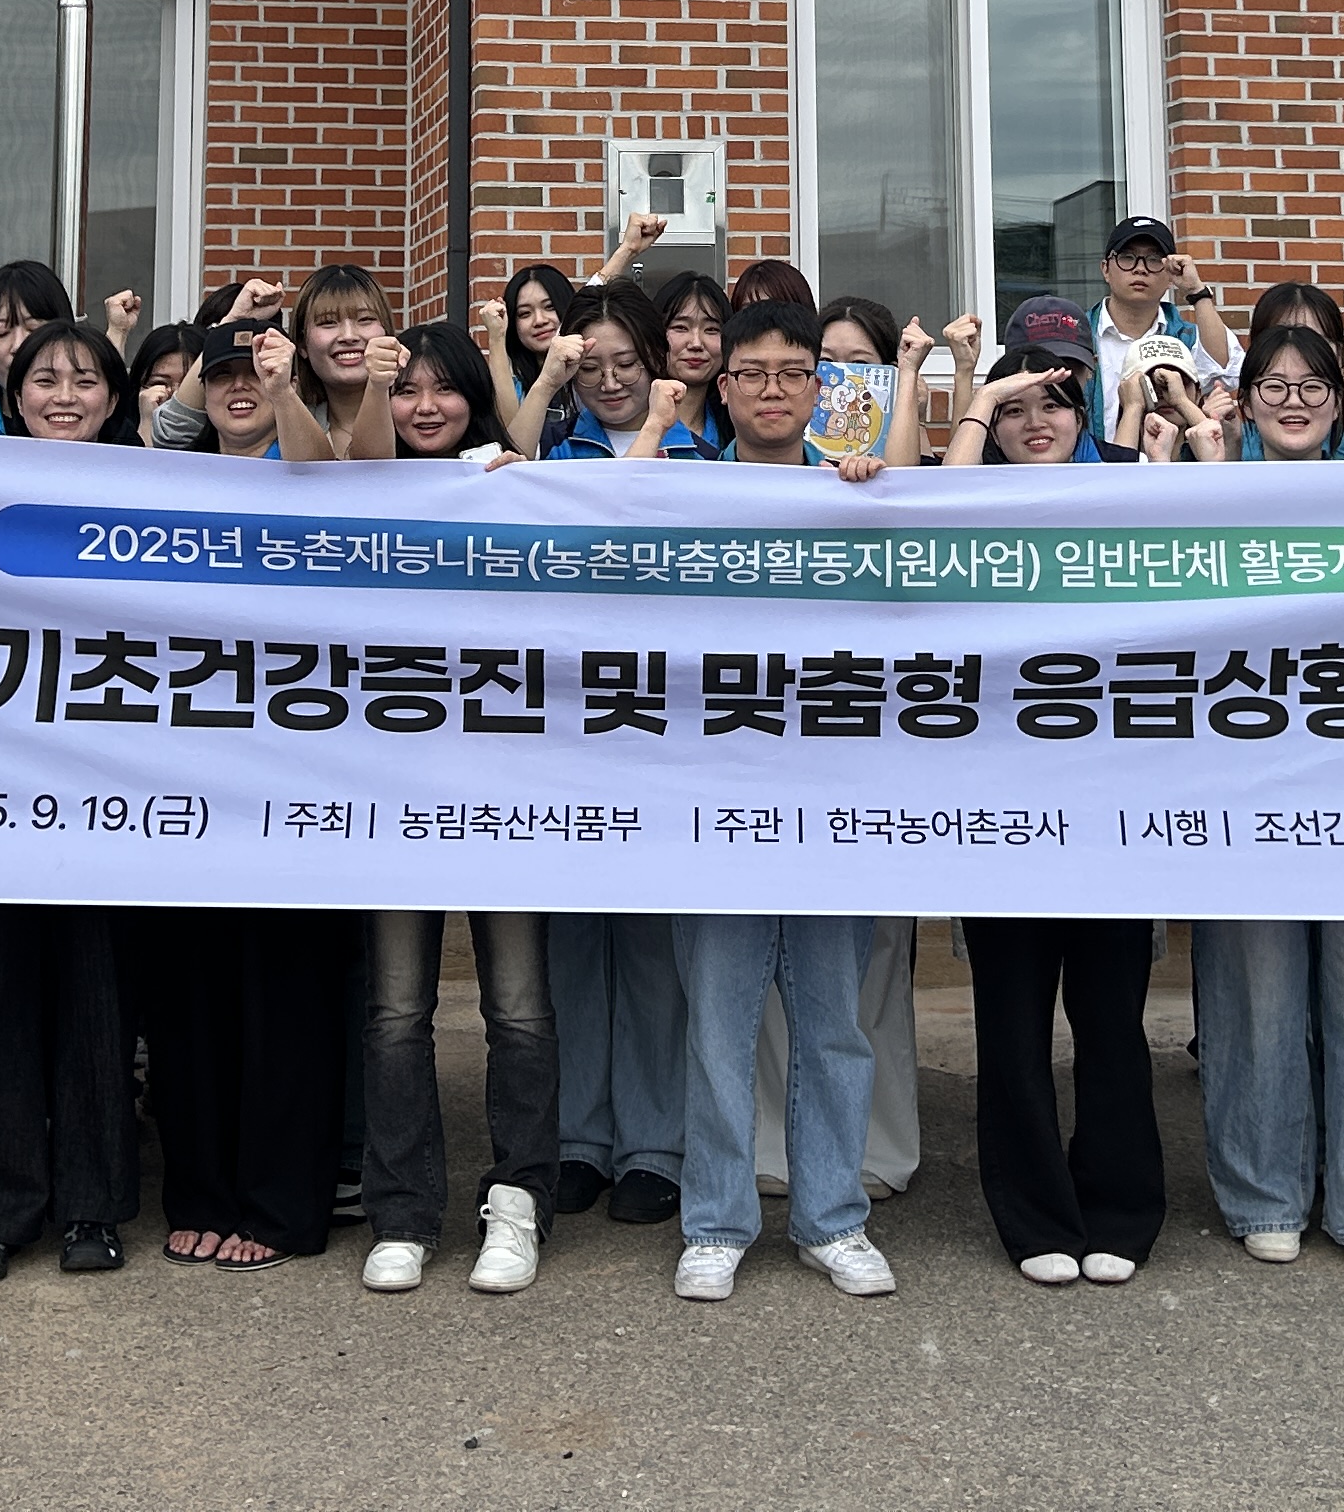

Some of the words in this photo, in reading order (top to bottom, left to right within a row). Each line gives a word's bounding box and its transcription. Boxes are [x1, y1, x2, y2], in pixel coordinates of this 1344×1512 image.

[77, 523, 243, 569] 2025년
[257, 526, 1041, 591] 농촌재능나눔(농촌맞춤형활동지원사업)
[1055, 540, 1228, 588] 일반단체
[582, 651, 668, 736] 및
[702, 651, 981, 738] 맞춤형
[399, 803, 642, 842] 농림축산식품부
[826, 807, 1070, 845] 한국농어촌공사
